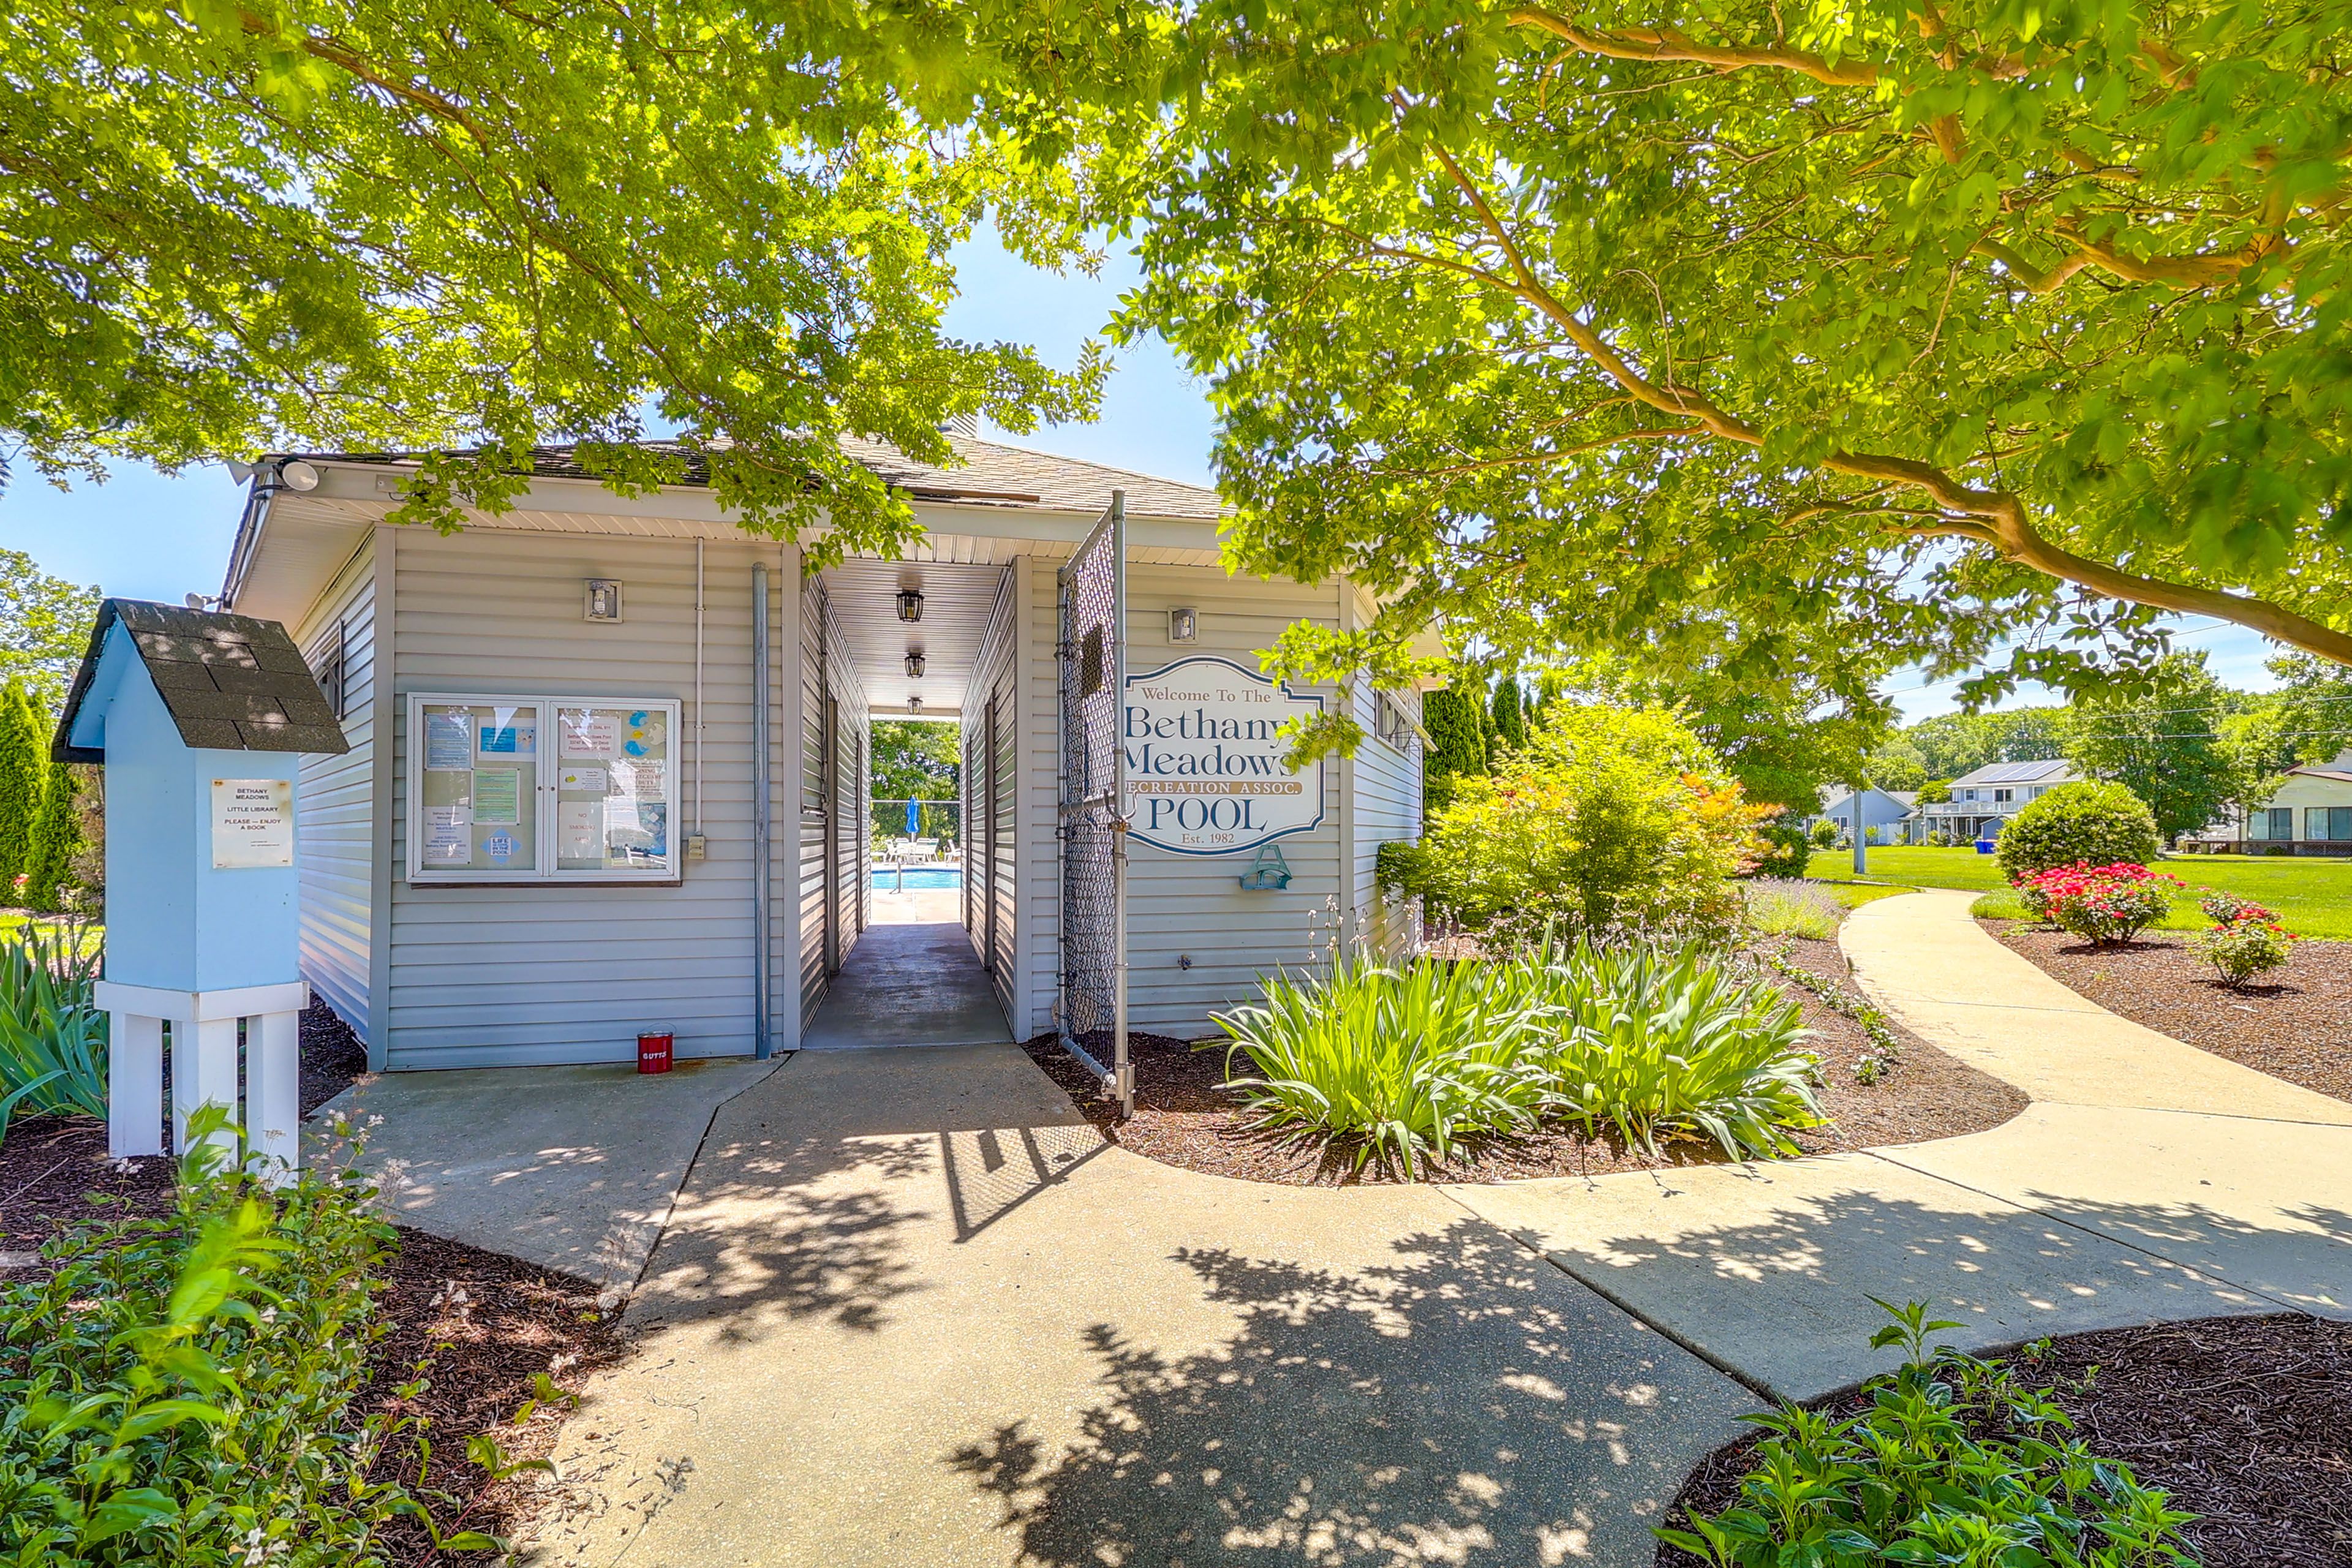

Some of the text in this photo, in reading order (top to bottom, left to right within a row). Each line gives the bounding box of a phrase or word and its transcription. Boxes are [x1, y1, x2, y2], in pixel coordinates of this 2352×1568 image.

[1142, 687, 1272, 703] Welcome To The
[1125, 706, 1290, 749] Bethany
[1125, 742, 1295, 778] Meadows
[1125, 781, 1298, 795] ECREATION ASSOC.
[1145, 797, 1268, 832] POOL
[1182, 833, 1235, 844] Est. 1982
[643, 1051, 667, 1060] BUTTS
